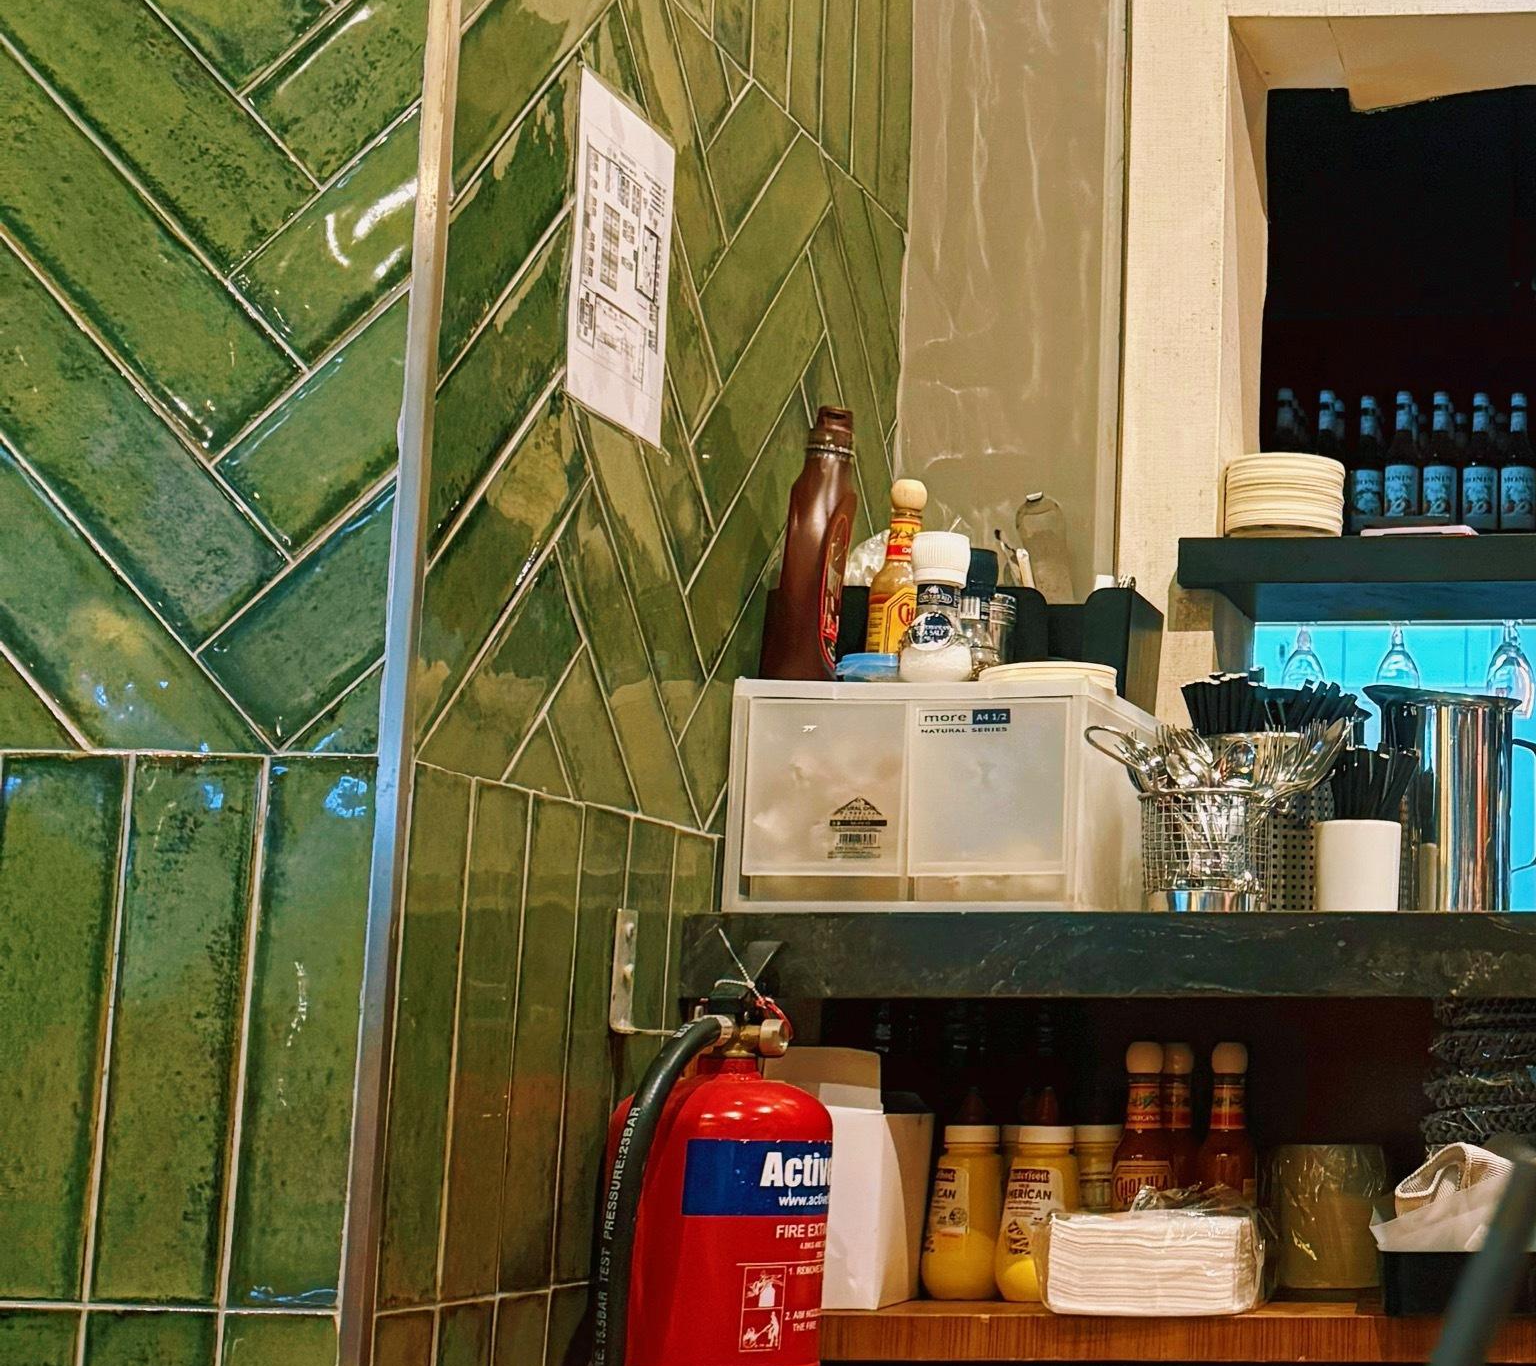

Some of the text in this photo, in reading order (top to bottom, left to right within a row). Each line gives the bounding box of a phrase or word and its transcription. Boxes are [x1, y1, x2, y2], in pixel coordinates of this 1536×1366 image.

[923, 712, 1008, 723] more A4 1/2
[775, 1224, 806, 1239] FIRE
